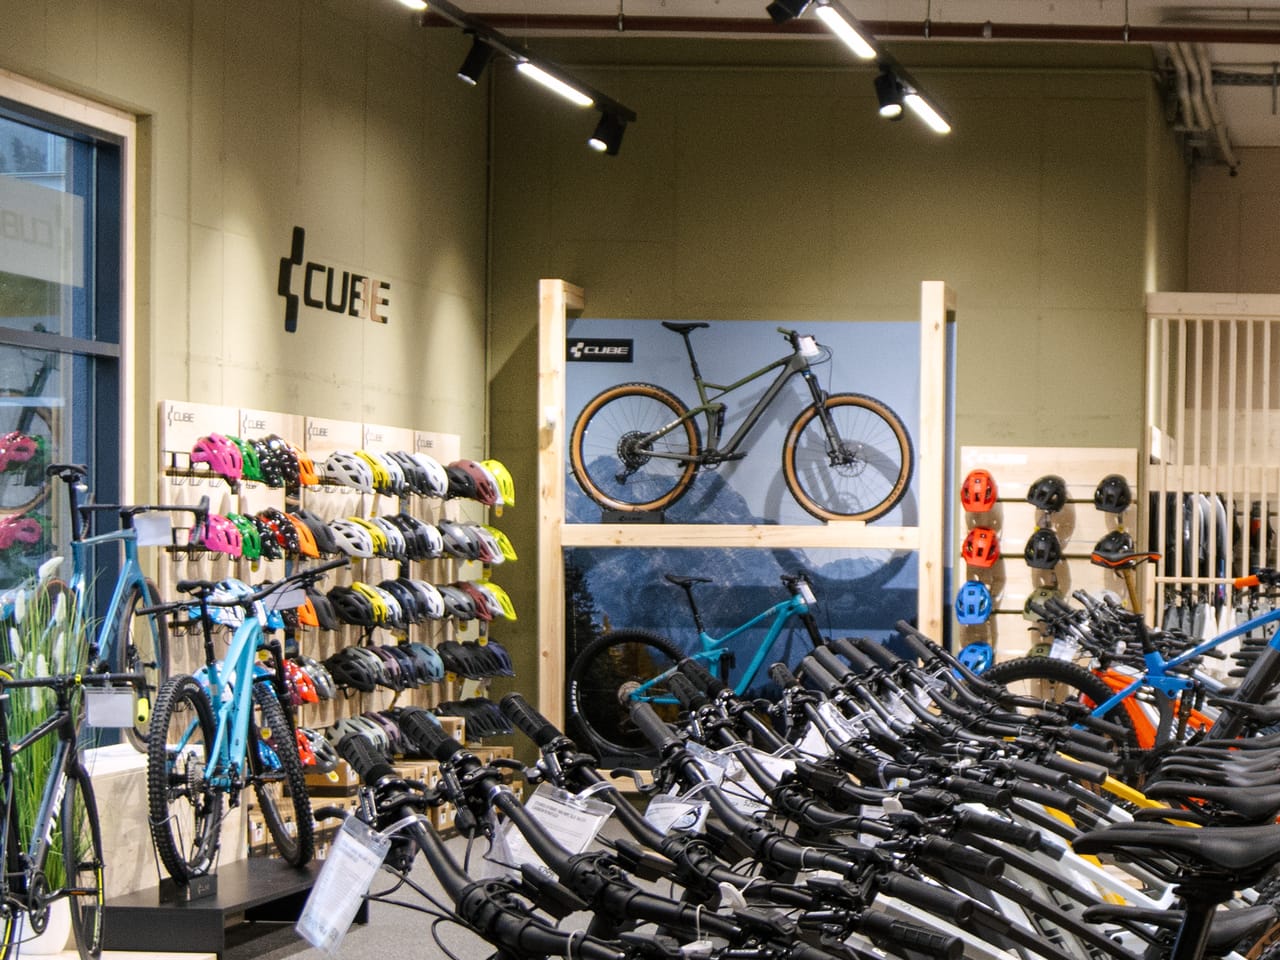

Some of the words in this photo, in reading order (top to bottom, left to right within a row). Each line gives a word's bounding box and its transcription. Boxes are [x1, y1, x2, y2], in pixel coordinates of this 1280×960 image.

[304, 261, 390, 324] CUBE
[583, 346, 629, 354] CUBE
[173, 411, 194, 423] CUBE
[312, 427, 328, 437] CUBE
